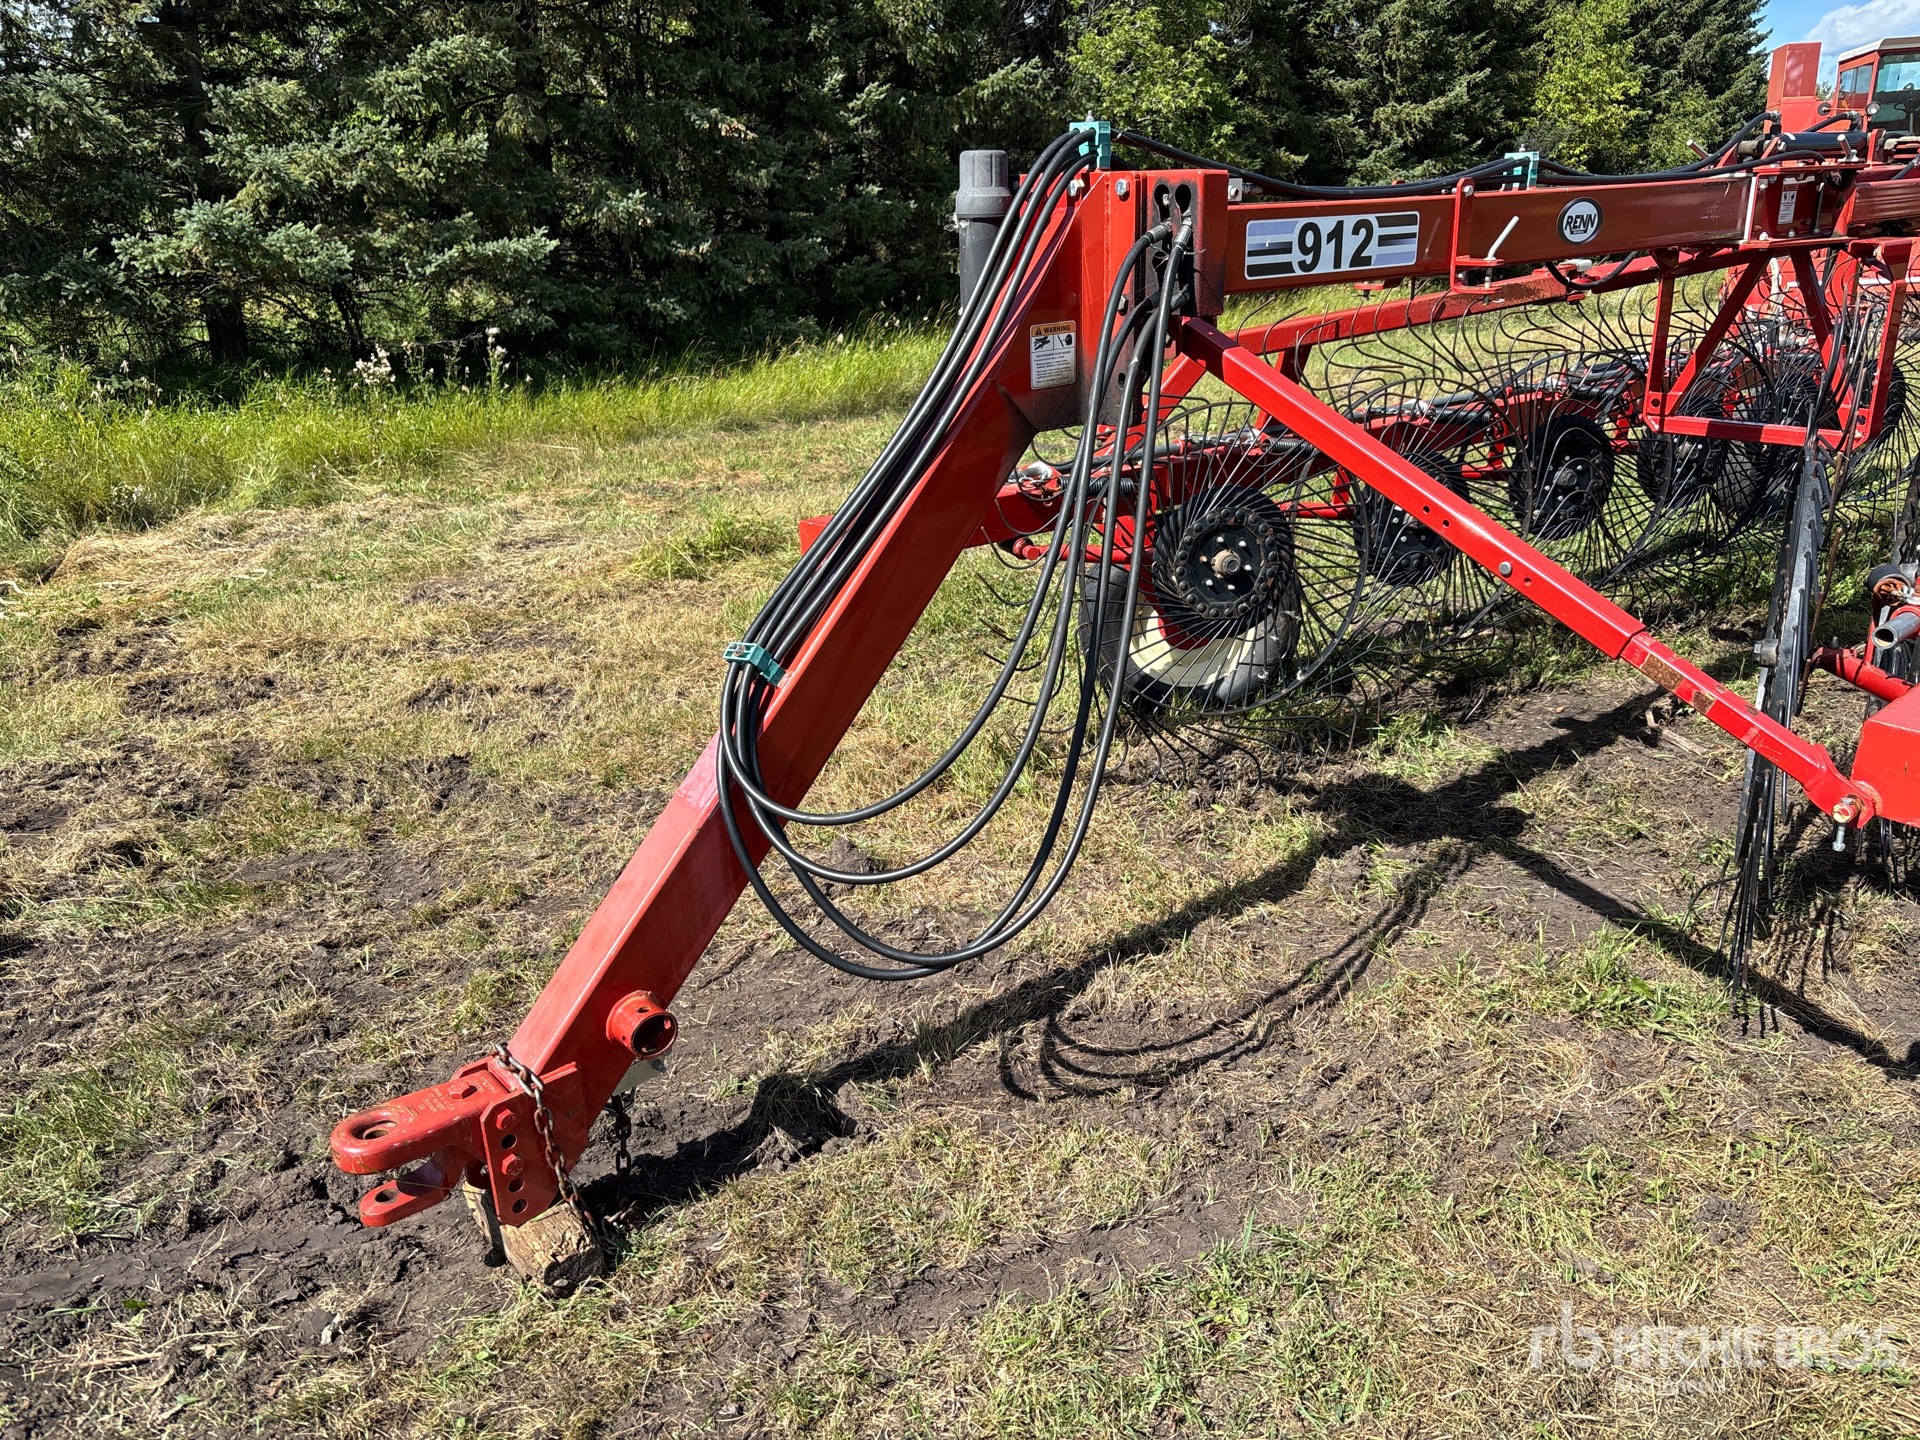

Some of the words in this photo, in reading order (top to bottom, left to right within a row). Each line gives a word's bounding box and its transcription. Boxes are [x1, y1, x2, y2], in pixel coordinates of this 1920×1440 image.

[1564, 213, 1597, 233] RENN
[1297, 218, 1374, 273] 912
[1043, 324, 1071, 334] WARNING
